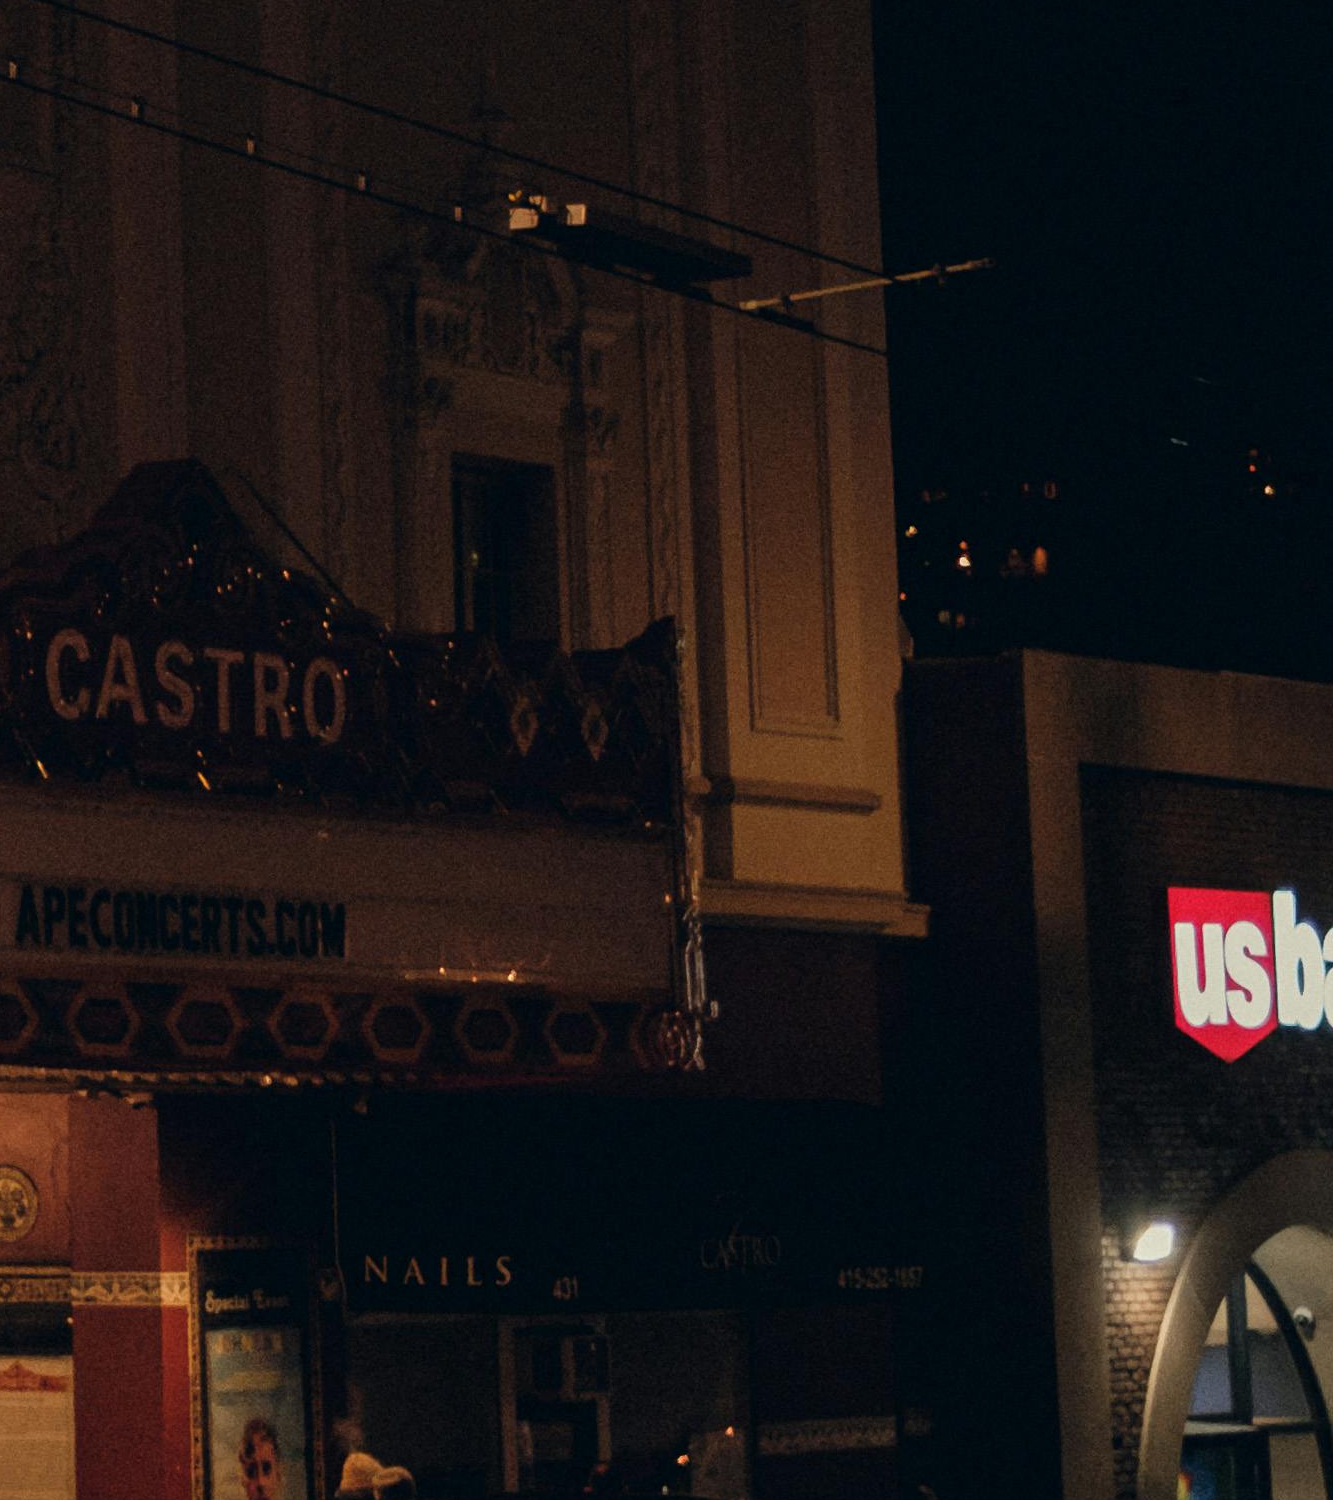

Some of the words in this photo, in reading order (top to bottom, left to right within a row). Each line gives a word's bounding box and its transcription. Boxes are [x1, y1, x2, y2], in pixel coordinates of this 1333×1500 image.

[44, 626, 348, 744] CASTRO
[16, 886, 345, 958] APECONCERTS.COM
[1174, 889, 1333, 1030] usb
[364, 1254, 515, 1287] NAILS
[551, 1274, 581, 1301] 431
